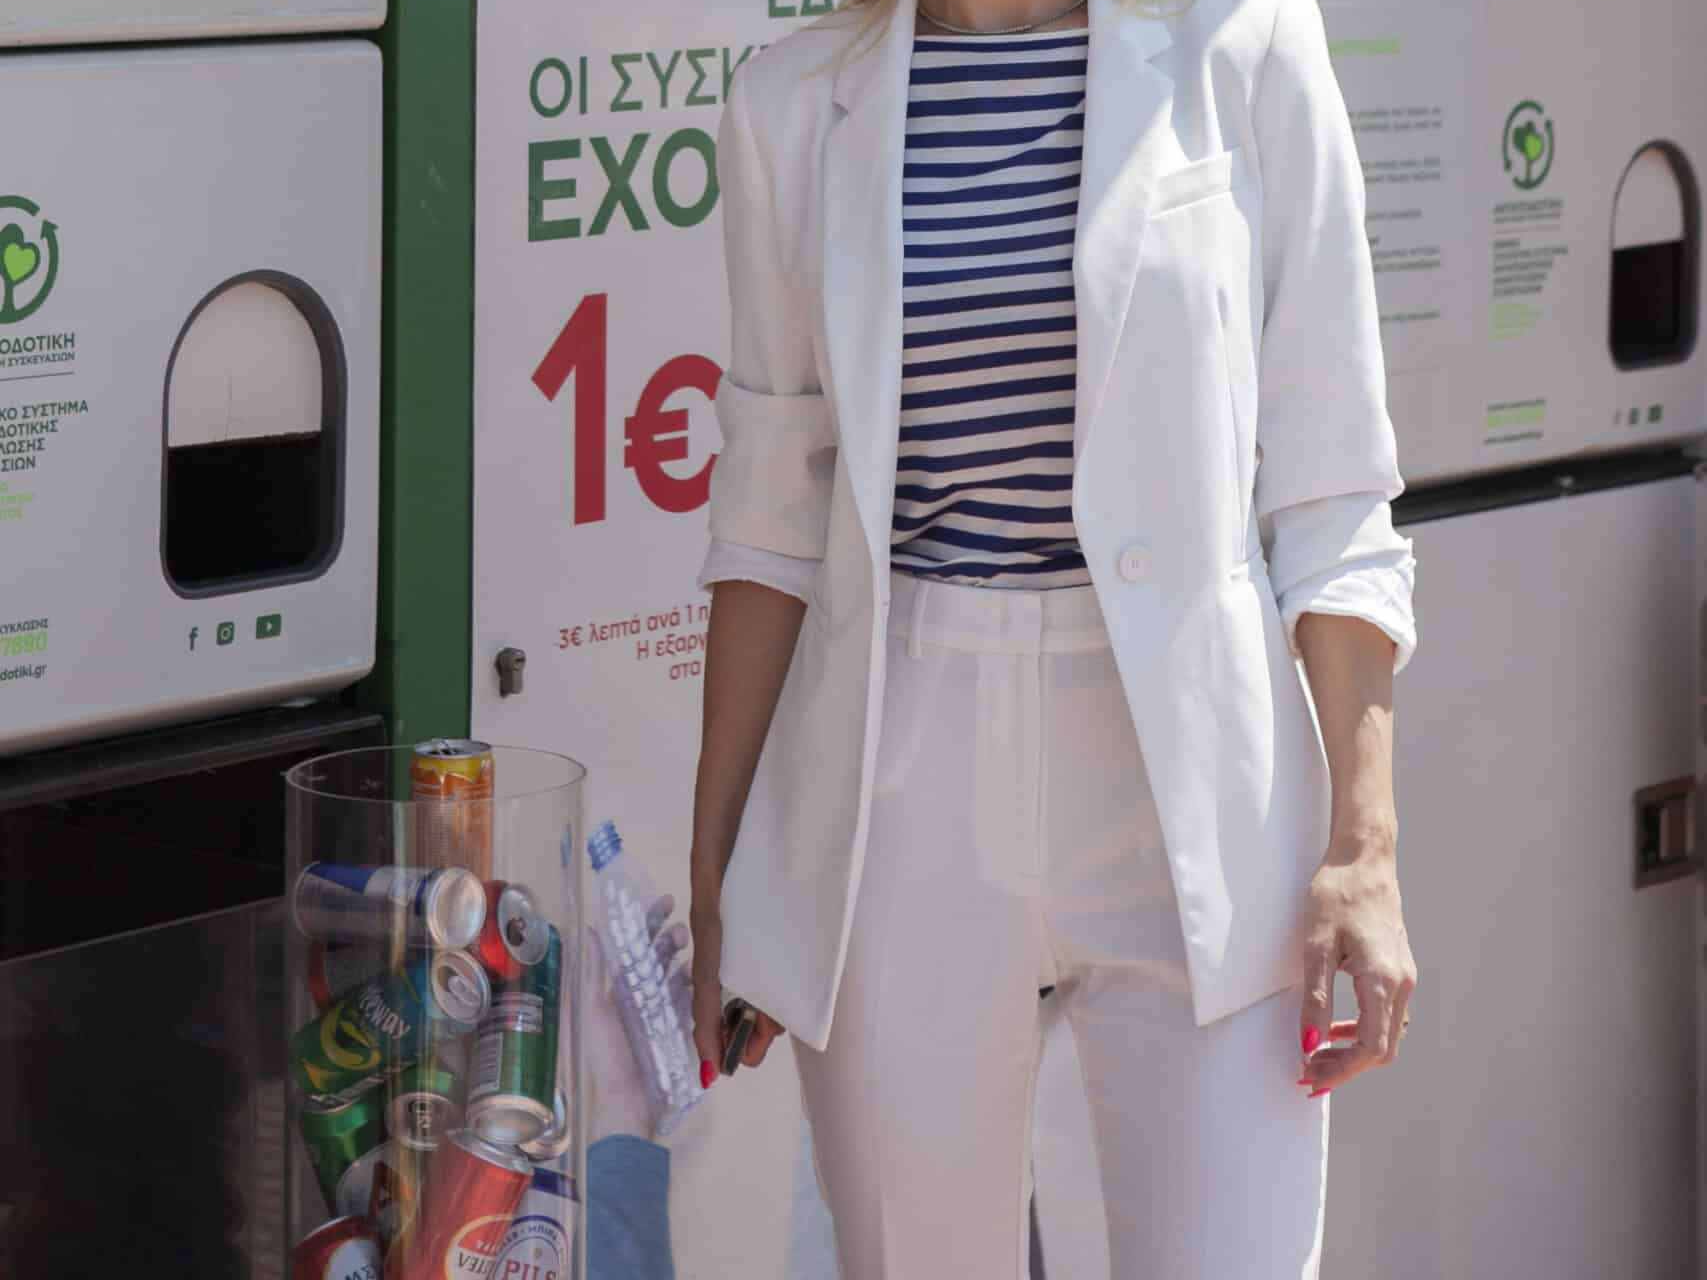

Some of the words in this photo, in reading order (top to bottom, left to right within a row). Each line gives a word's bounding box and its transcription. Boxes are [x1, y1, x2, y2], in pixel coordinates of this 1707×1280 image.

[529, 56, 588, 118] ΟΙ
[610, 45, 760, 112] ΣΥΣΚ
[528, 127, 719, 242] ΕΧΟ
[22, 400, 88, 418] ΣΥΣΤΗΜΑ
[531, 293, 724, 525] 1€
[559, 626, 582, 650] 3€
[589, 614, 640, 644] λεπτά
[647, 607, 680, 632] ανά
[685, 604, 693, 625] 1
[698, 605, 709, 622] π
[636, 640, 649, 661] Η
